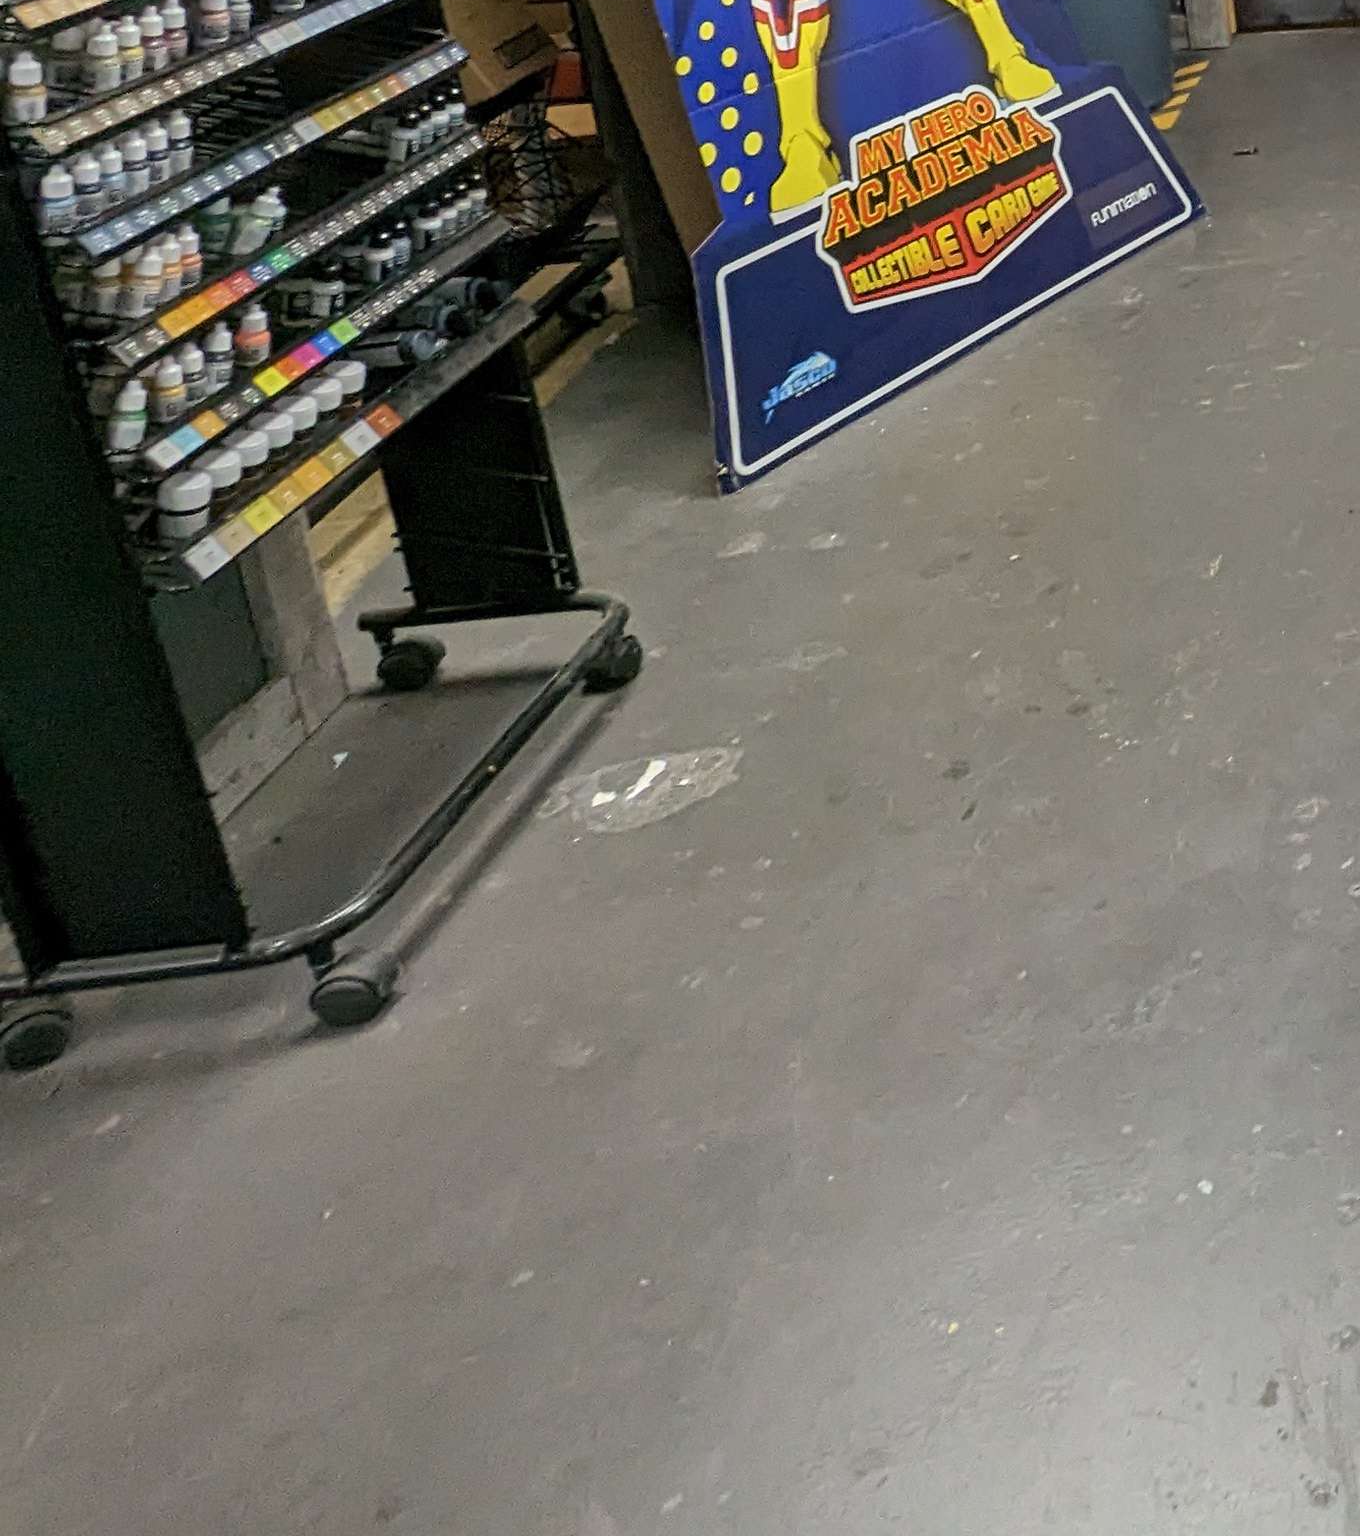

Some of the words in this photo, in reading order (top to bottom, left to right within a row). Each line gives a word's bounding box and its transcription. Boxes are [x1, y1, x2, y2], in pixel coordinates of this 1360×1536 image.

[824, 106, 1055, 248] ACADEMIA
[856, 123, 906, 180] MY
[910, 90, 997, 153] HERO
[849, 222, 966, 295] COLLECTIBLE
[964, 185, 1033, 255] CARD
[1026, 170, 1061, 208] GAME
